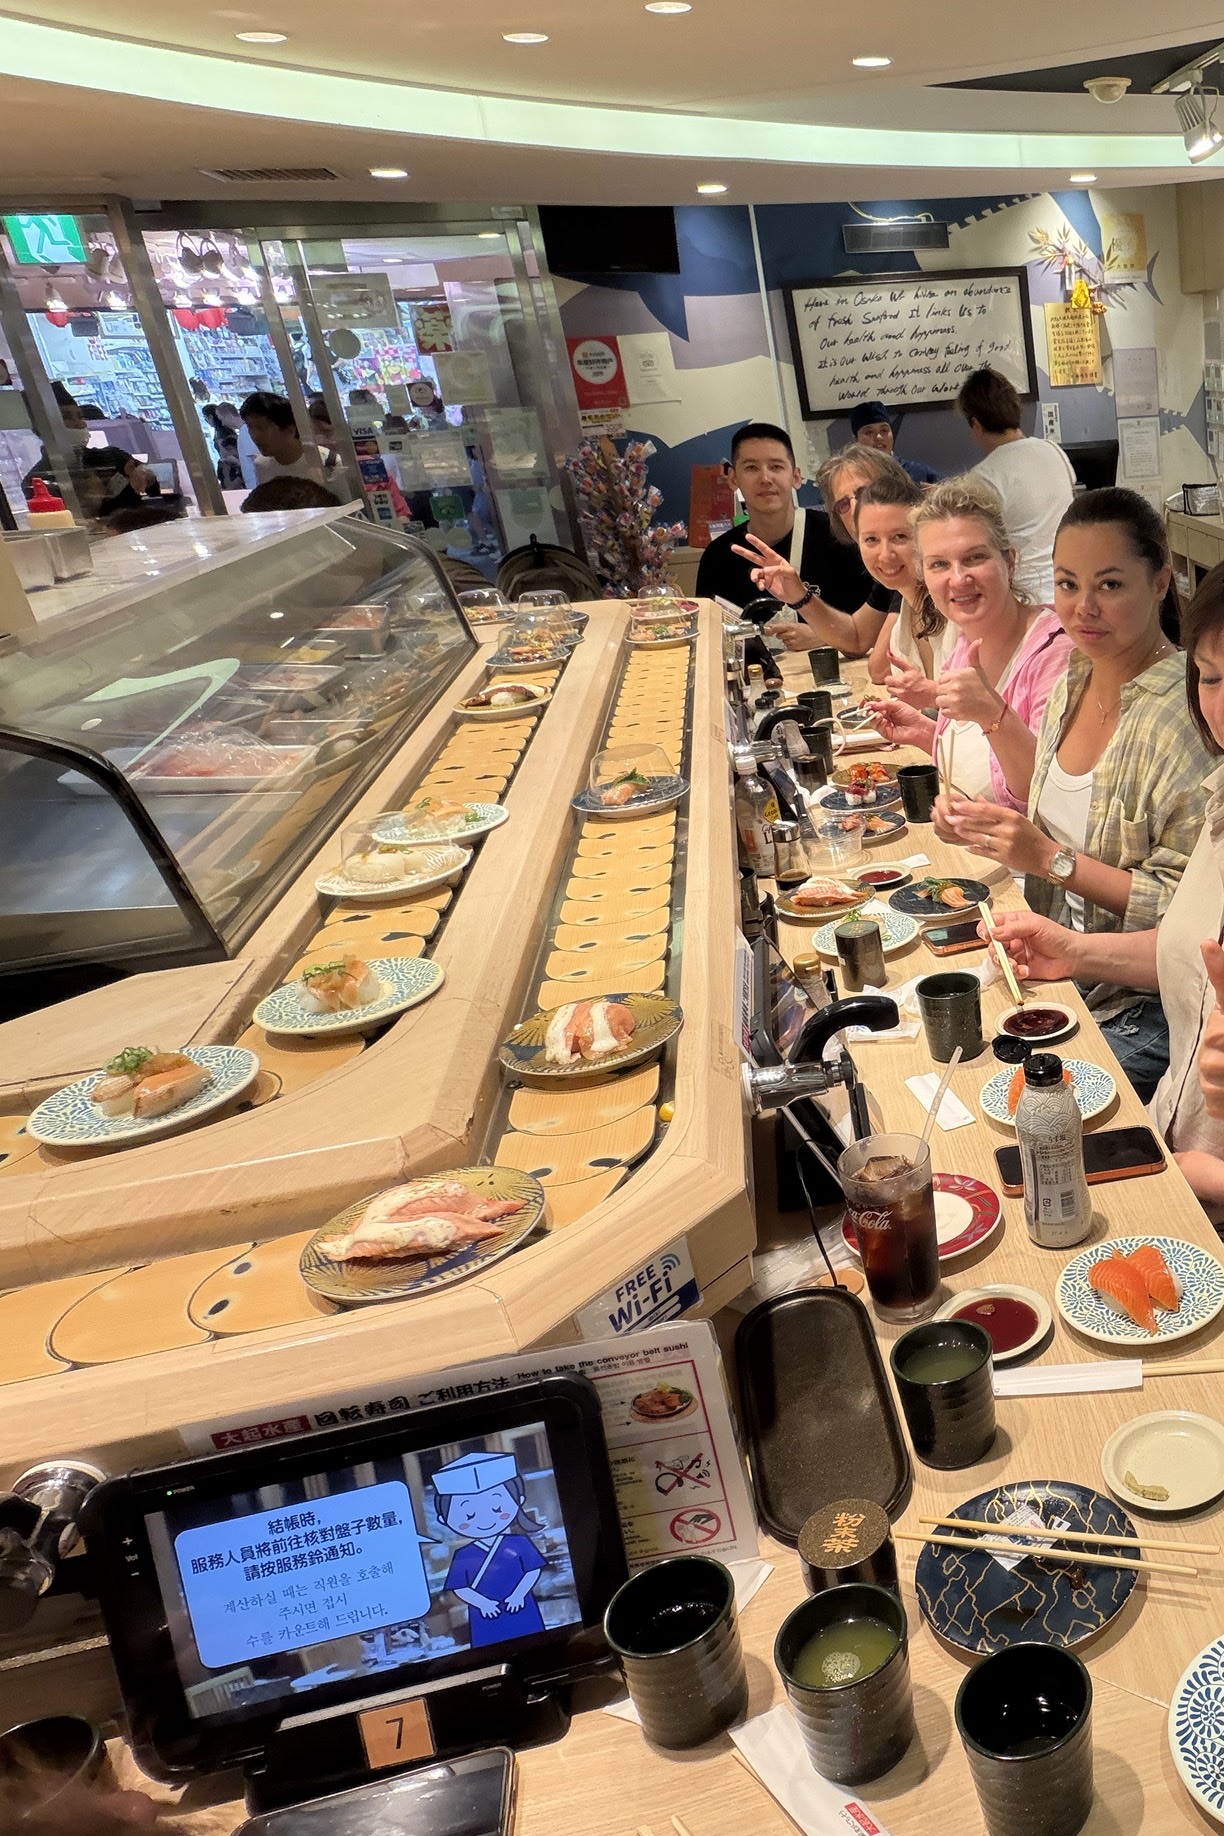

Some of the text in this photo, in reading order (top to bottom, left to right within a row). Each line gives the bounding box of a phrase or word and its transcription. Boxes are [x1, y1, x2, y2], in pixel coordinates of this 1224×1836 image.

[353, 427, 373, 435] VISA
[608, 1270, 672, 1333] Wi-Fi
[615, 1264, 656, 1303] FREE
[517, 1342, 689, 1380] How to take the conveyor belt sushi
[314, 1376, 510, 1427] 回転寿司 ご利用方法
[221, 1418, 305, 1447] 大起水産
[173, 1486, 195, 1494] POWER
[822, 1512, 866, 1553] 粉末茶
[125, 1554, 139, 1562] Vol
[243, 1541, 363, 1582] 請按服務鈴通知。
[224, 1561, 394, 1614] 계산하실 때는 직원을 호출해
[246, 1603, 389, 1648] 수를 카운트해 드립니다.
[279, 1593, 348, 1621] 주시면 접시
[385, 1717, 404, 1750] 7
